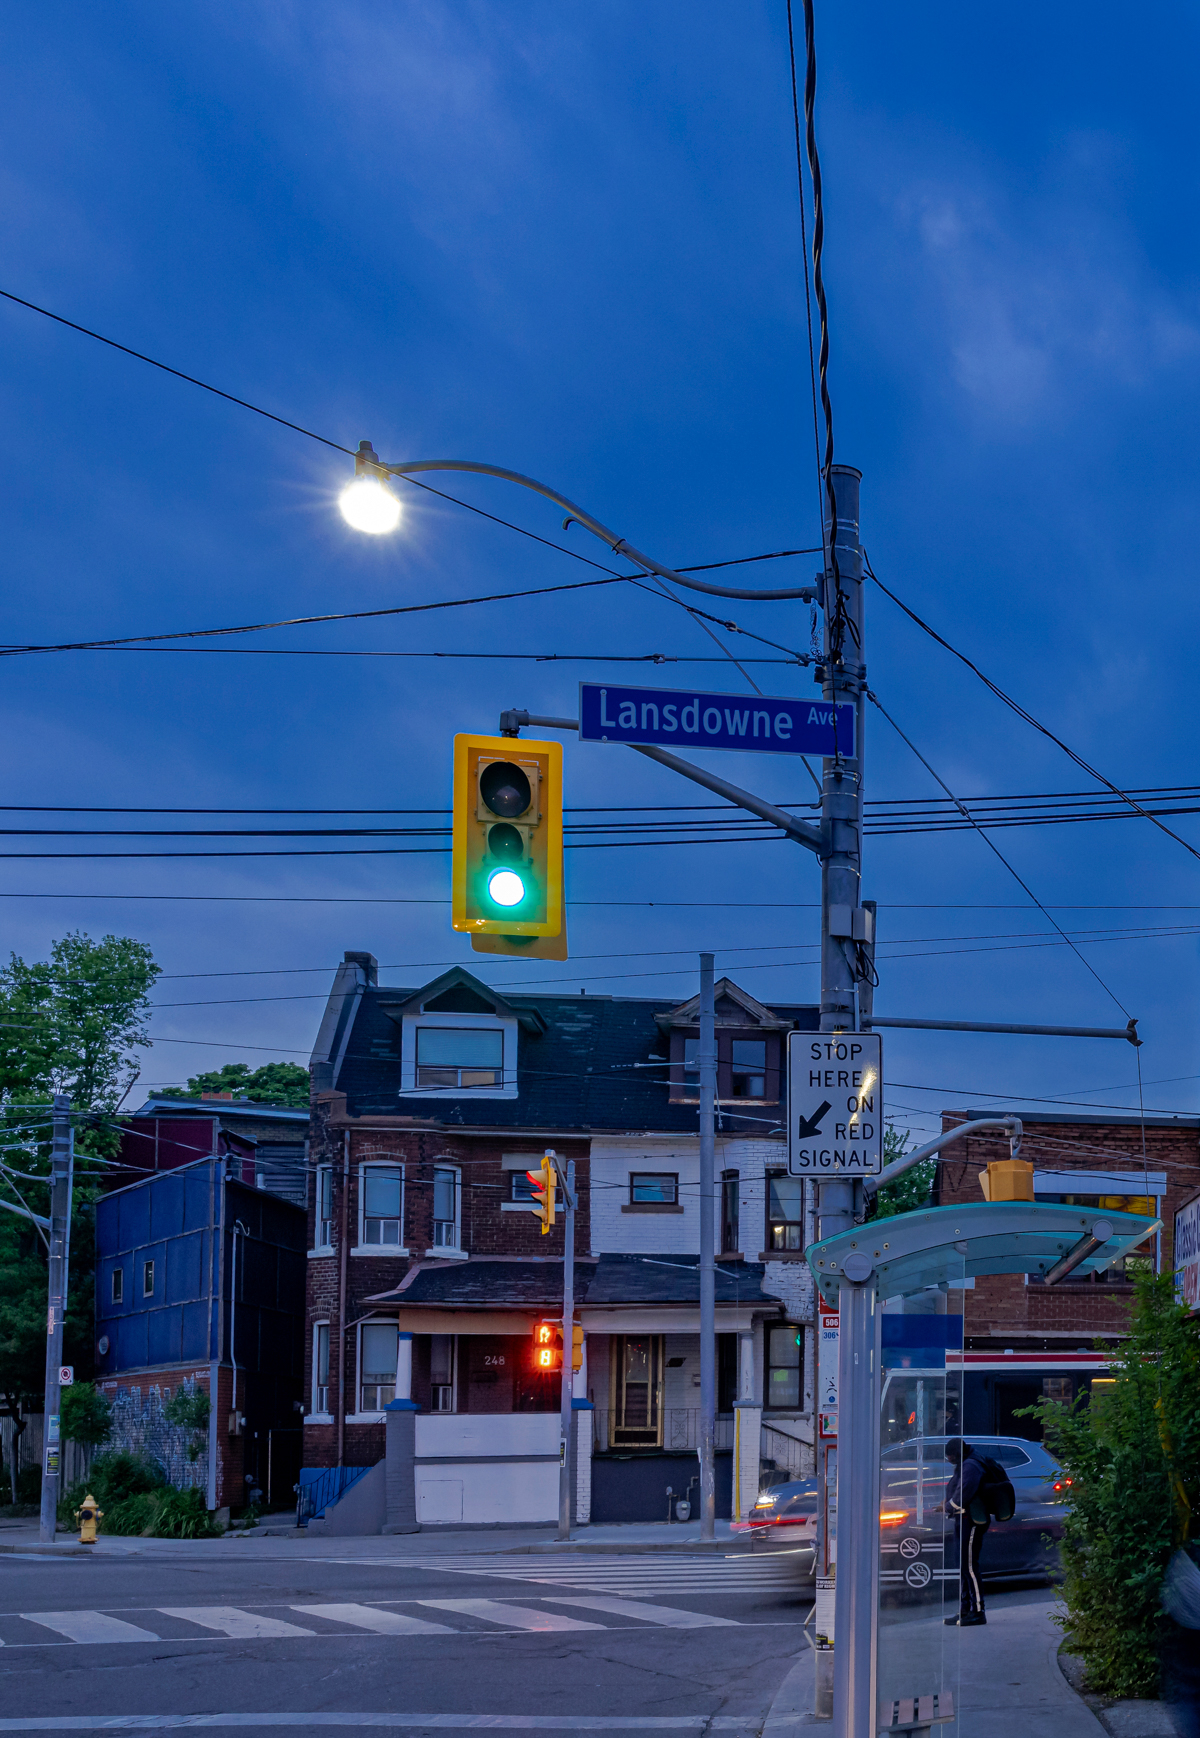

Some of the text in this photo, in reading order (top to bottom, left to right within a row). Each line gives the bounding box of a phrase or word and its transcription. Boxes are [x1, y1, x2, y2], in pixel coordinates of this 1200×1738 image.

[600, 691, 838, 739] Lansdowne Ave
[811, 1043, 862, 1060] STOP
[810, 1070, 862, 1087] HERE
[847, 1096, 873, 1113] ON
[835, 1123, 874, 1140] RED
[799, 1149, 874, 1167] SIGNAL
[1177, 1210, 1196, 1263] Classic
[1184, 1261, 1198, 1304] OPEN
[825, 1318, 838, 1326] 506
[823, 1331, 836, 1339] 306
[484, 1355, 505, 1365] 248
